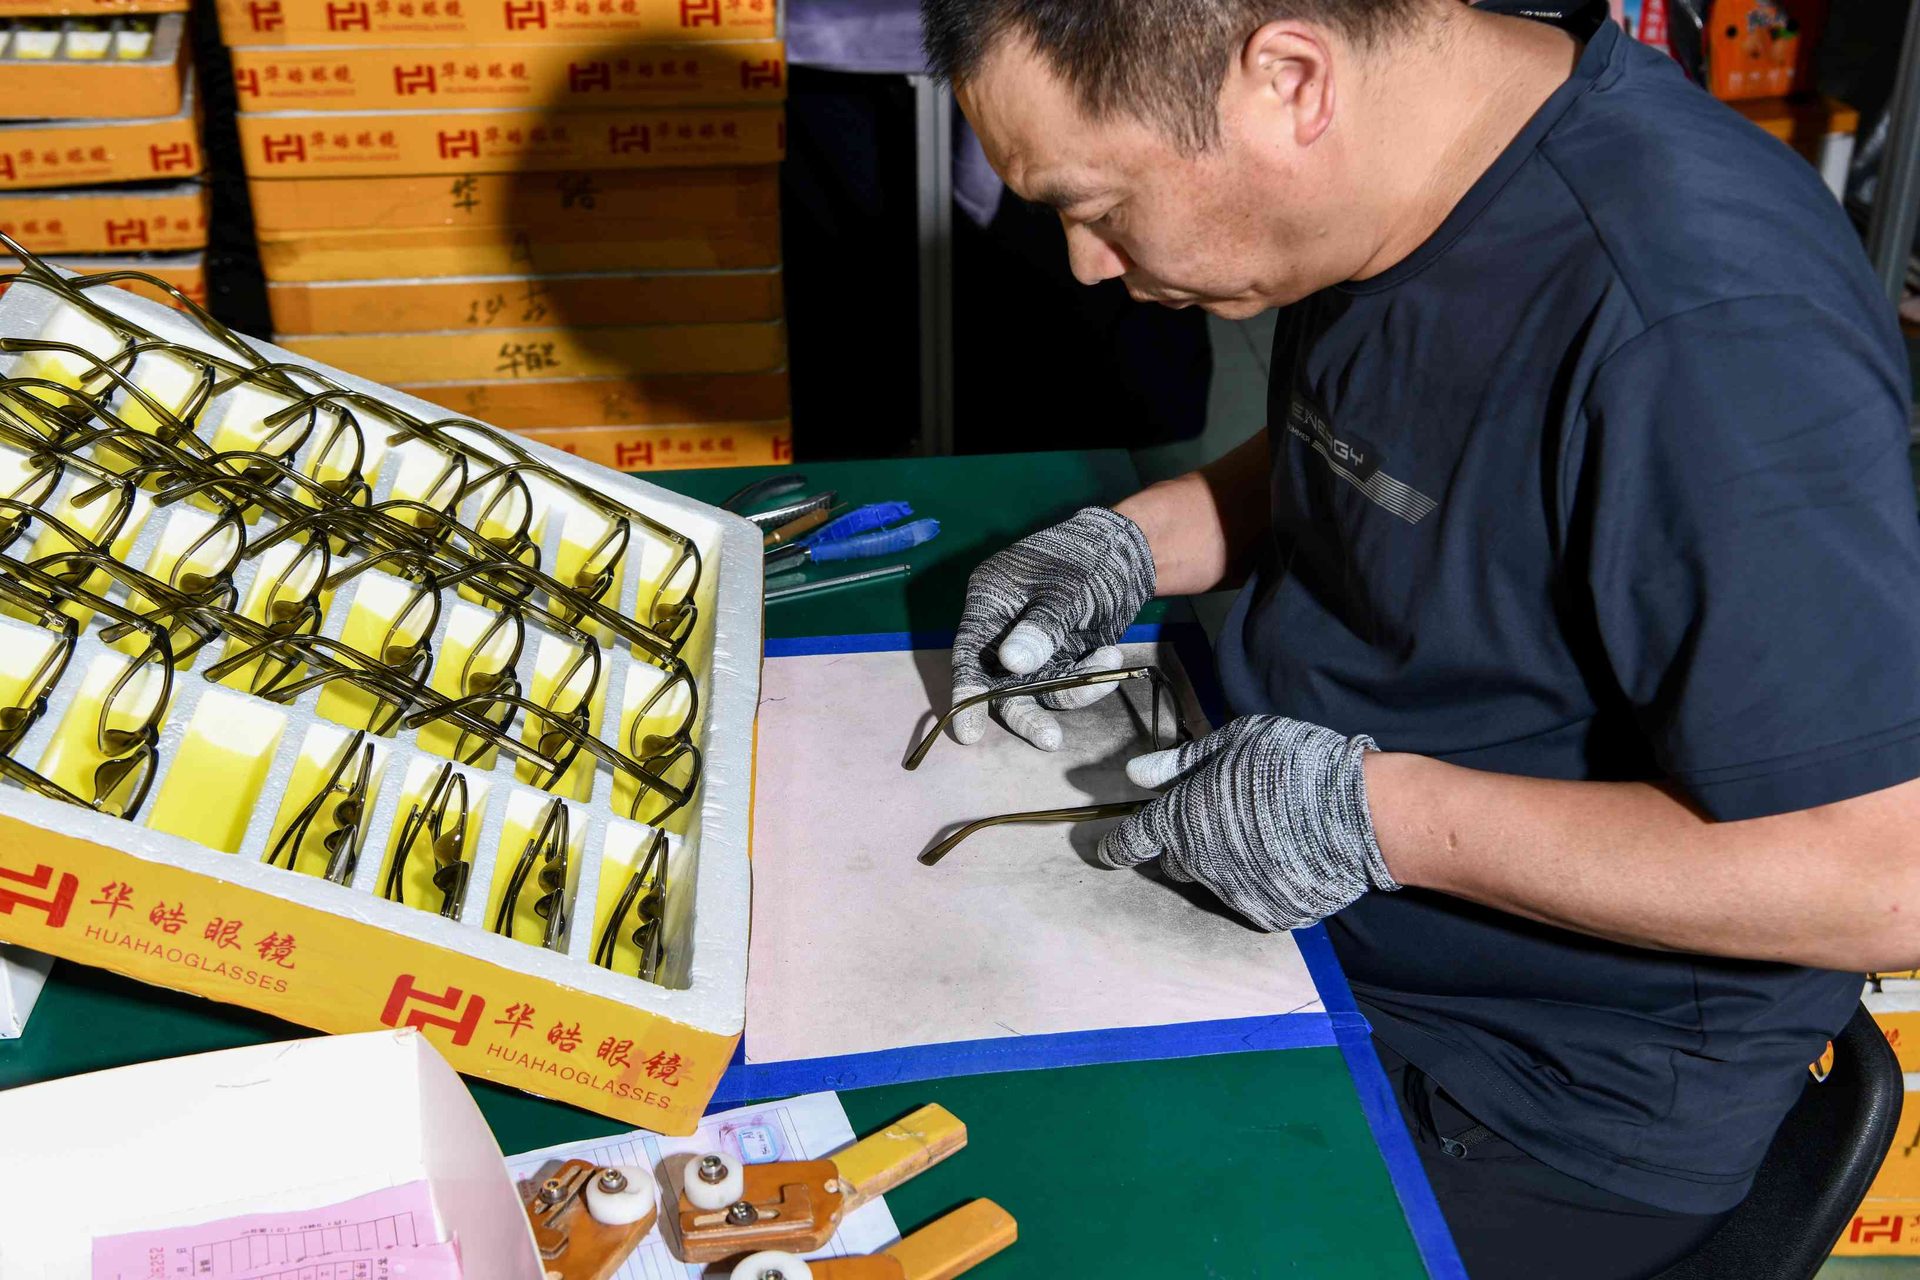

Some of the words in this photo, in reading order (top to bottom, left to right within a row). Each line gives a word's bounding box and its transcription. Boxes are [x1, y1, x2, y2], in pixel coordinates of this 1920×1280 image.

[84, 924, 289, 994] HUAHAOGLASSES
[90, 881, 298, 970] 华皓眼镜
[486, 1042, 671, 1110] HUAHAOGLASSES
[493, 1002, 684, 1088] 华皓眼镜
